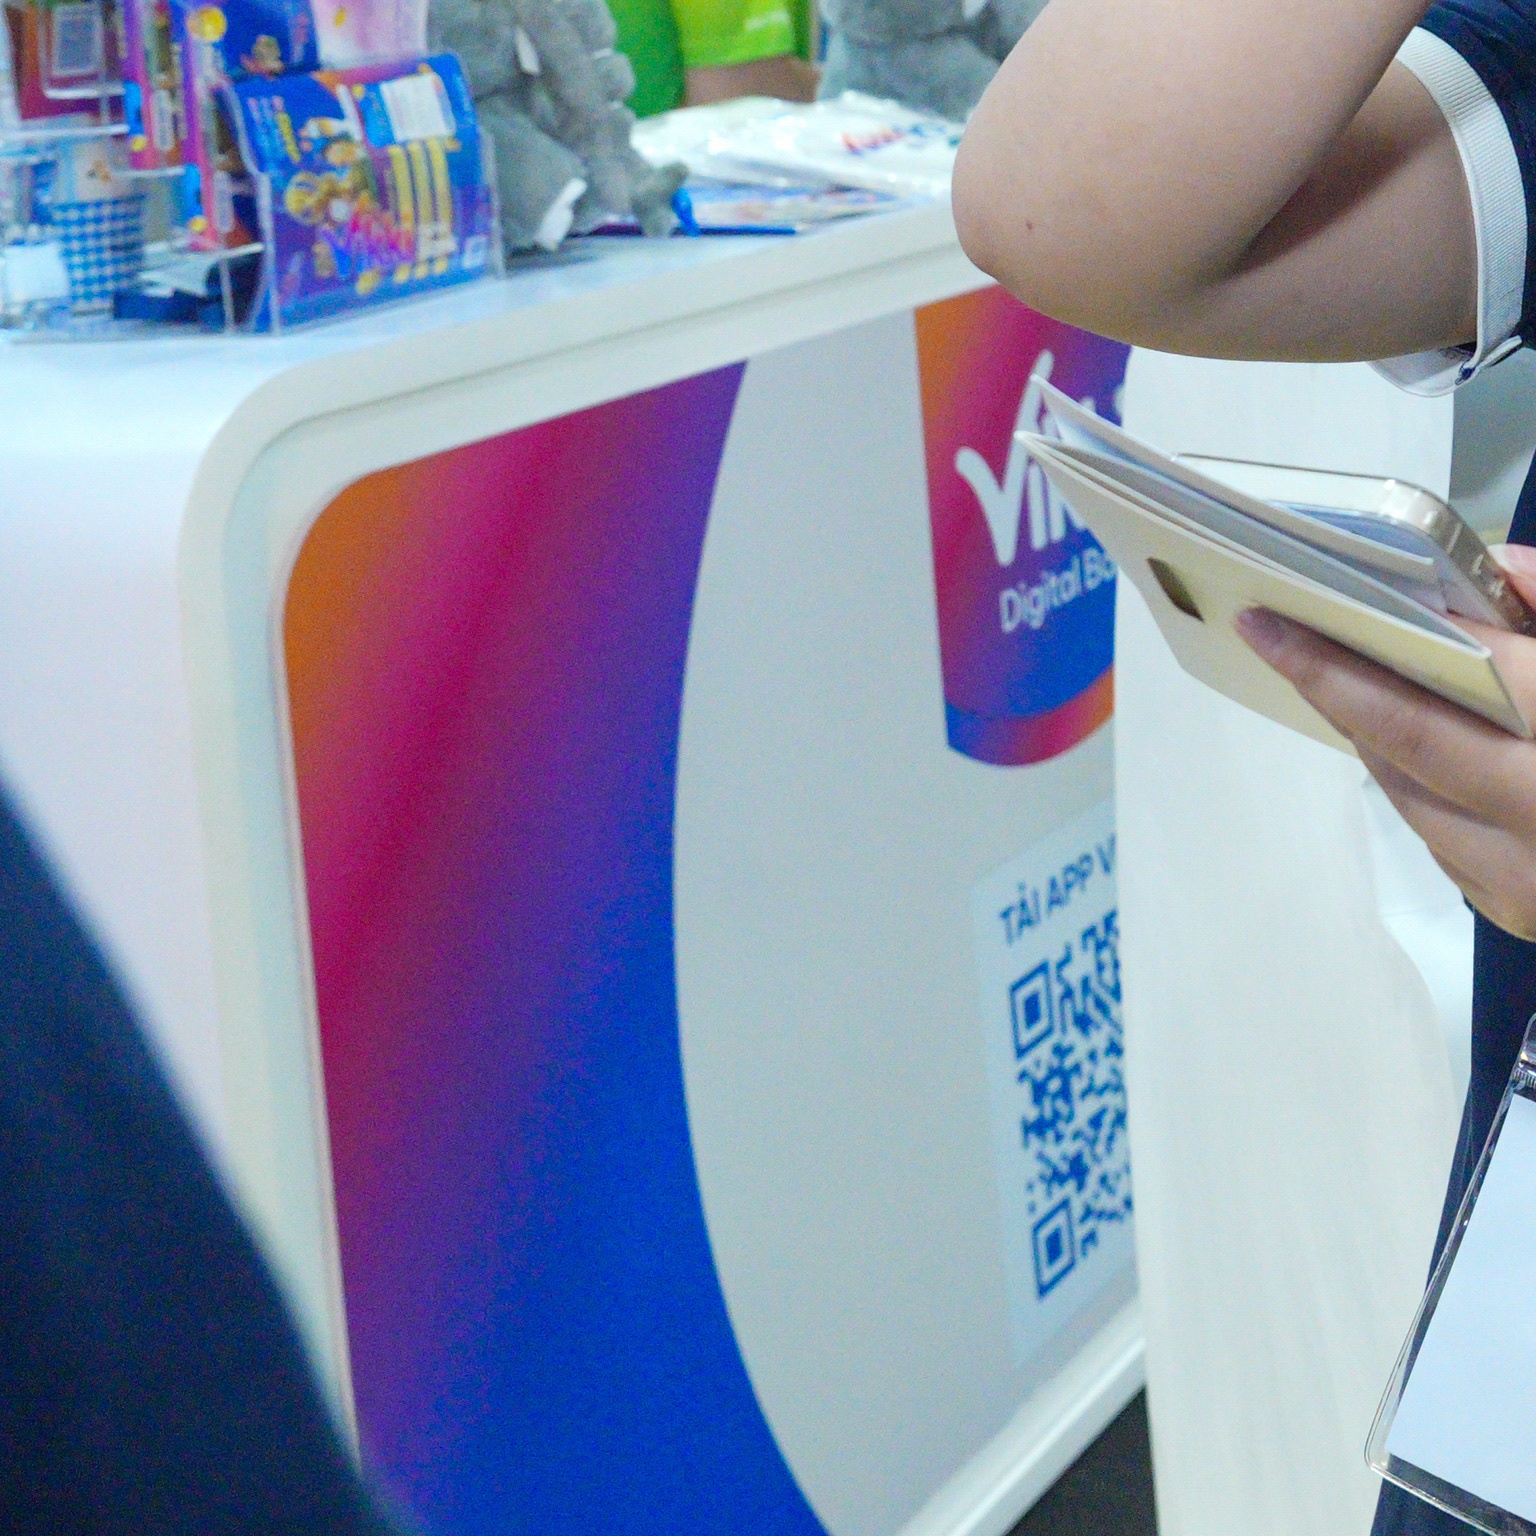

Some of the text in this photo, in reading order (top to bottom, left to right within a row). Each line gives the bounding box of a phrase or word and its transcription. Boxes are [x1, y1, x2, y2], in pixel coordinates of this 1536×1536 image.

[1000, 546, 1118, 634] Digital Ba
[1047, 853, 1094, 914] APP
